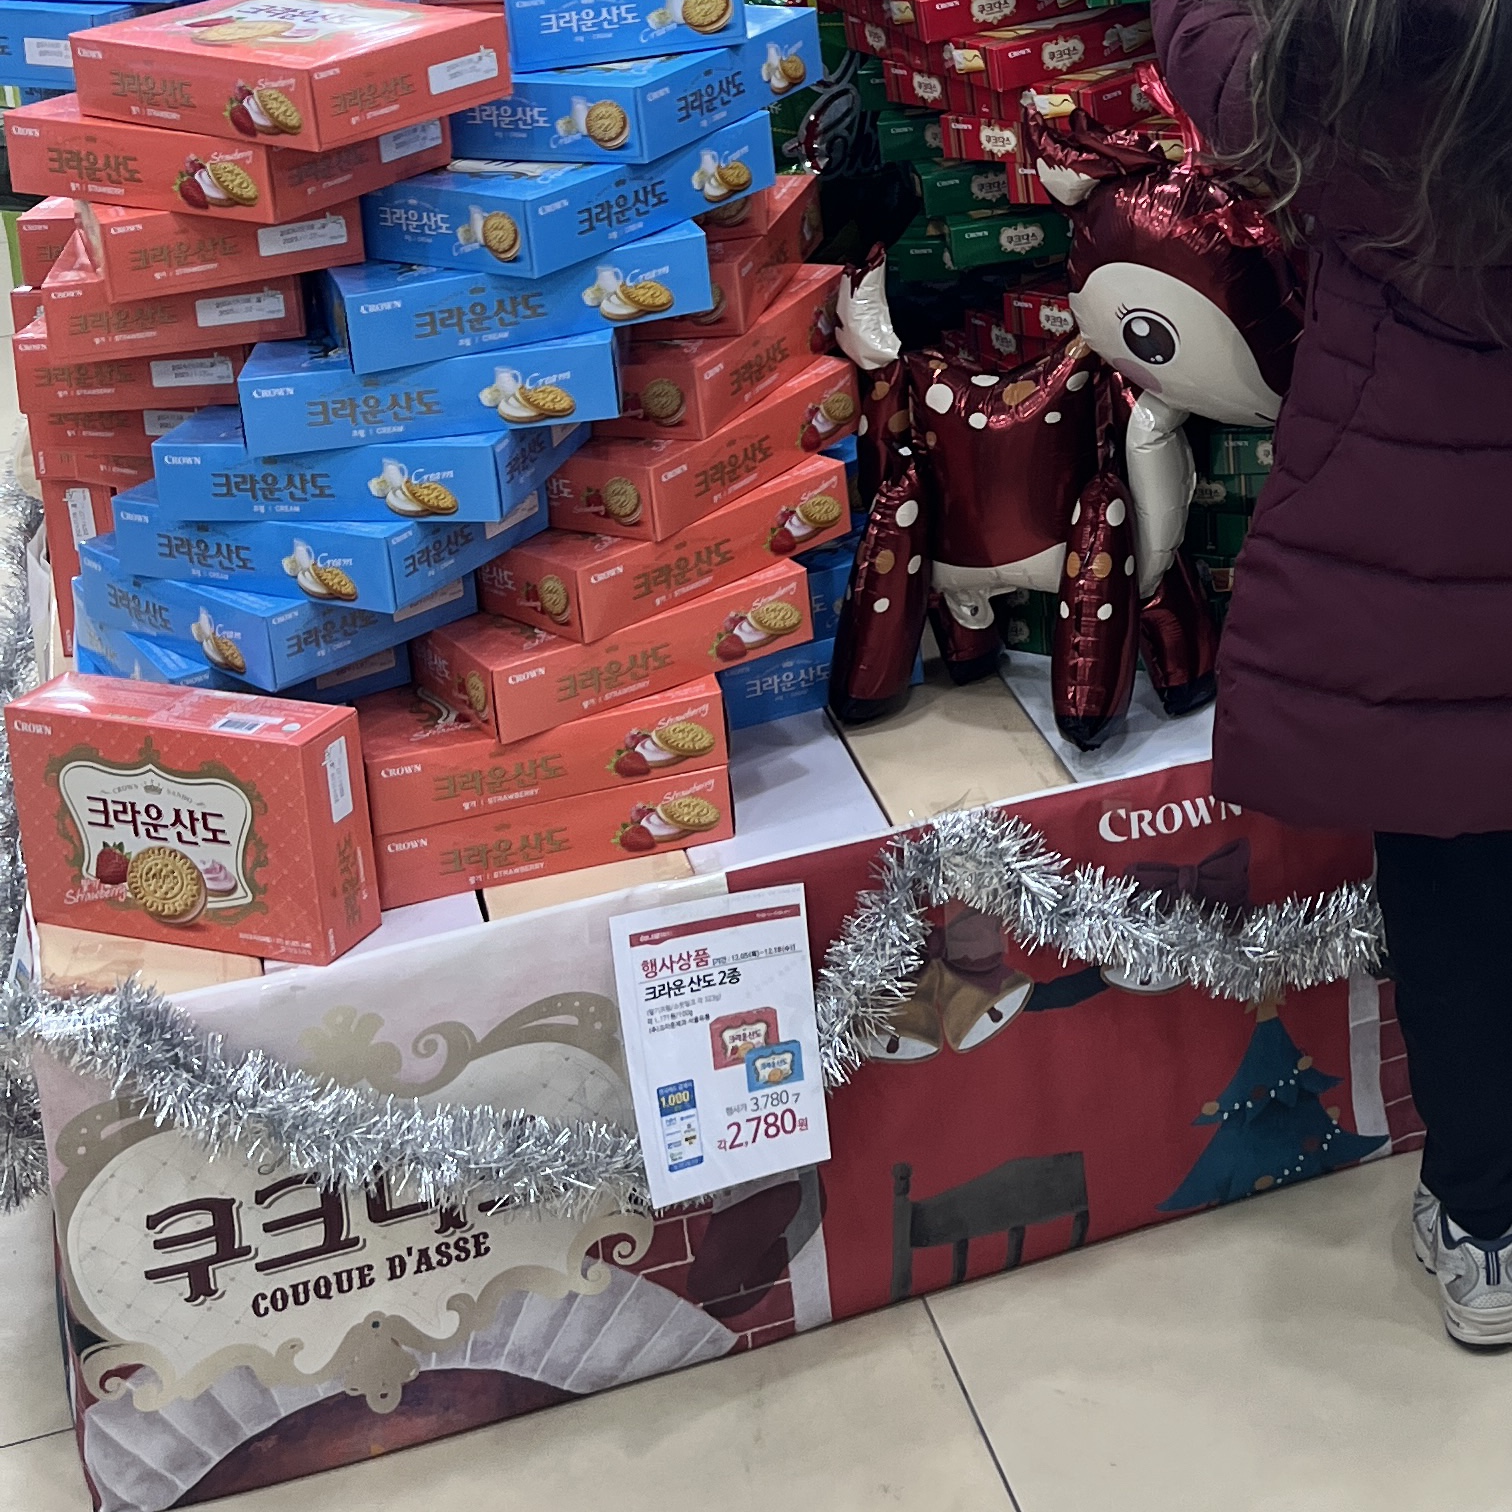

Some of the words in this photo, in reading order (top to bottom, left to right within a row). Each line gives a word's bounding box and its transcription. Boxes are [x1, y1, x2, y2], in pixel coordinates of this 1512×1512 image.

[539, 3, 641, 35] 크라운산도
[577, 180, 669, 237] 크라운산도
[360, 300, 401, 314] CROWN
[414, 293, 547, 340] 크라운산도
[306, 390, 444, 428] 크라운산도
[164, 455, 201, 465] CROWN
[211, 472, 336, 502] 크라운산도
[120, 511, 149, 524] CROWN
[157, 533, 256, 572] 크라운산도
[507, 668, 546, 685] CROWN
[13, 720, 52, 735] CROWN
[380, 764, 422, 778] CROWN
[87, 795, 231, 847] 크라운산도
[1098, 797, 1244, 844] CROWN
[387, 838, 428, 853] CROWN
[641, 948, 711, 979] 행사상품
[645, 979, 686, 1001] 크라운
[688, 973, 716, 993] 산도
[718, 967, 742, 985] 2종
[252, 1264, 375, 1318] COUQUE
[386, 1231, 491, 1283] D'ASSE
